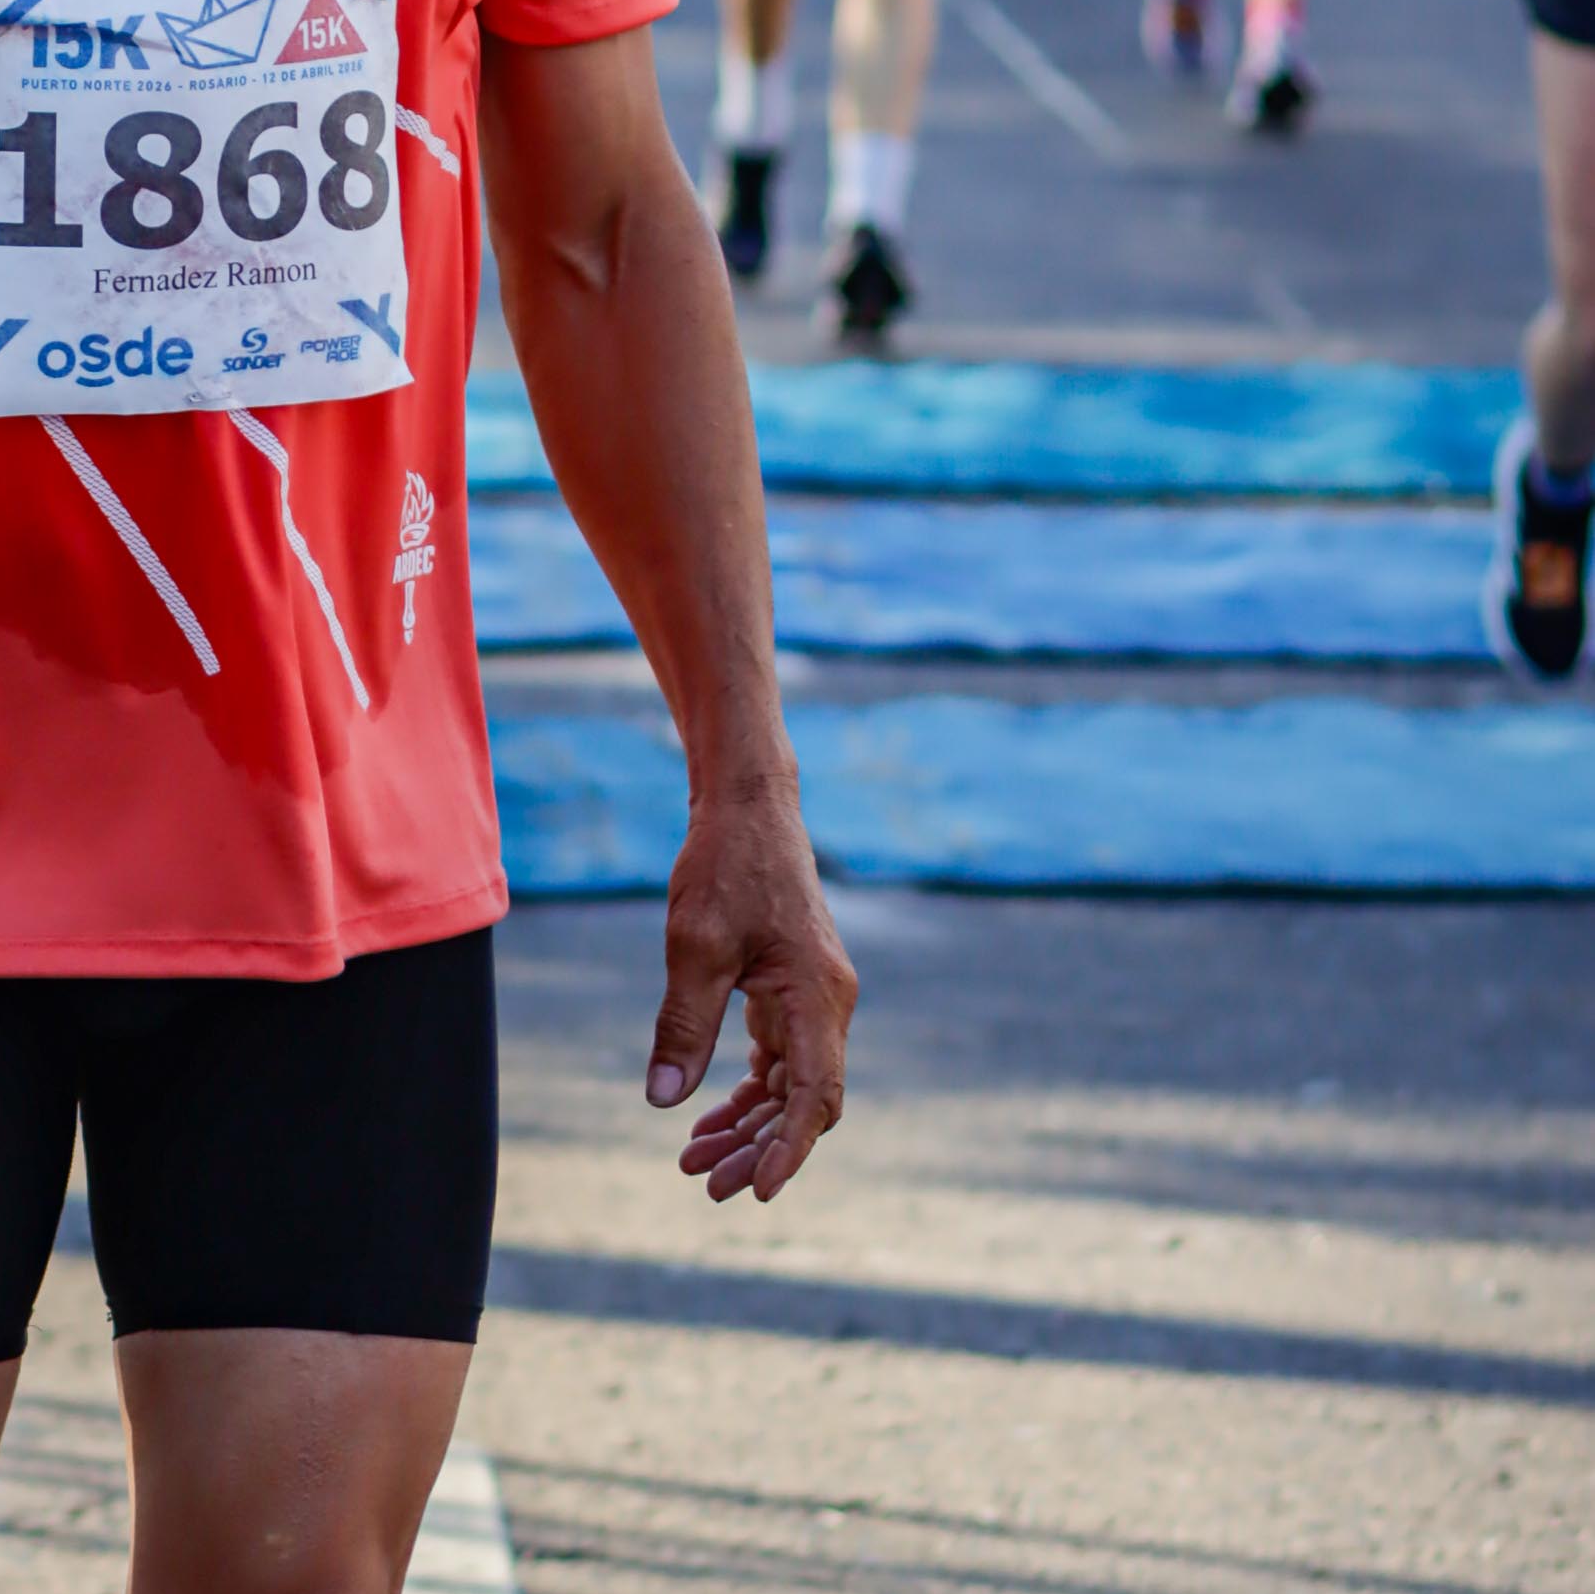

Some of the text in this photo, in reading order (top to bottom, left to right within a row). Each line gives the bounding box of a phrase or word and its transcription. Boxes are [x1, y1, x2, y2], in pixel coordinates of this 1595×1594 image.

[21, 13, 150, 71] 15K
[297, 13, 348, 52] 15K
[21, 77, 78, 91] PUERTO
[83, 79, 132, 92] NORTE
[137, 80, 173, 93] 2026
[189, 75, 248, 91] ROSARIO
[262, 72, 276, 84] 12
[281, 69, 297, 82] DE
[301, 65, 334, 80] ABRIL
[94, 261, 318, 294] Fernadez Ramon
[37, 325, 194, 381] osde
[300, 334, 362, 354] POWER
